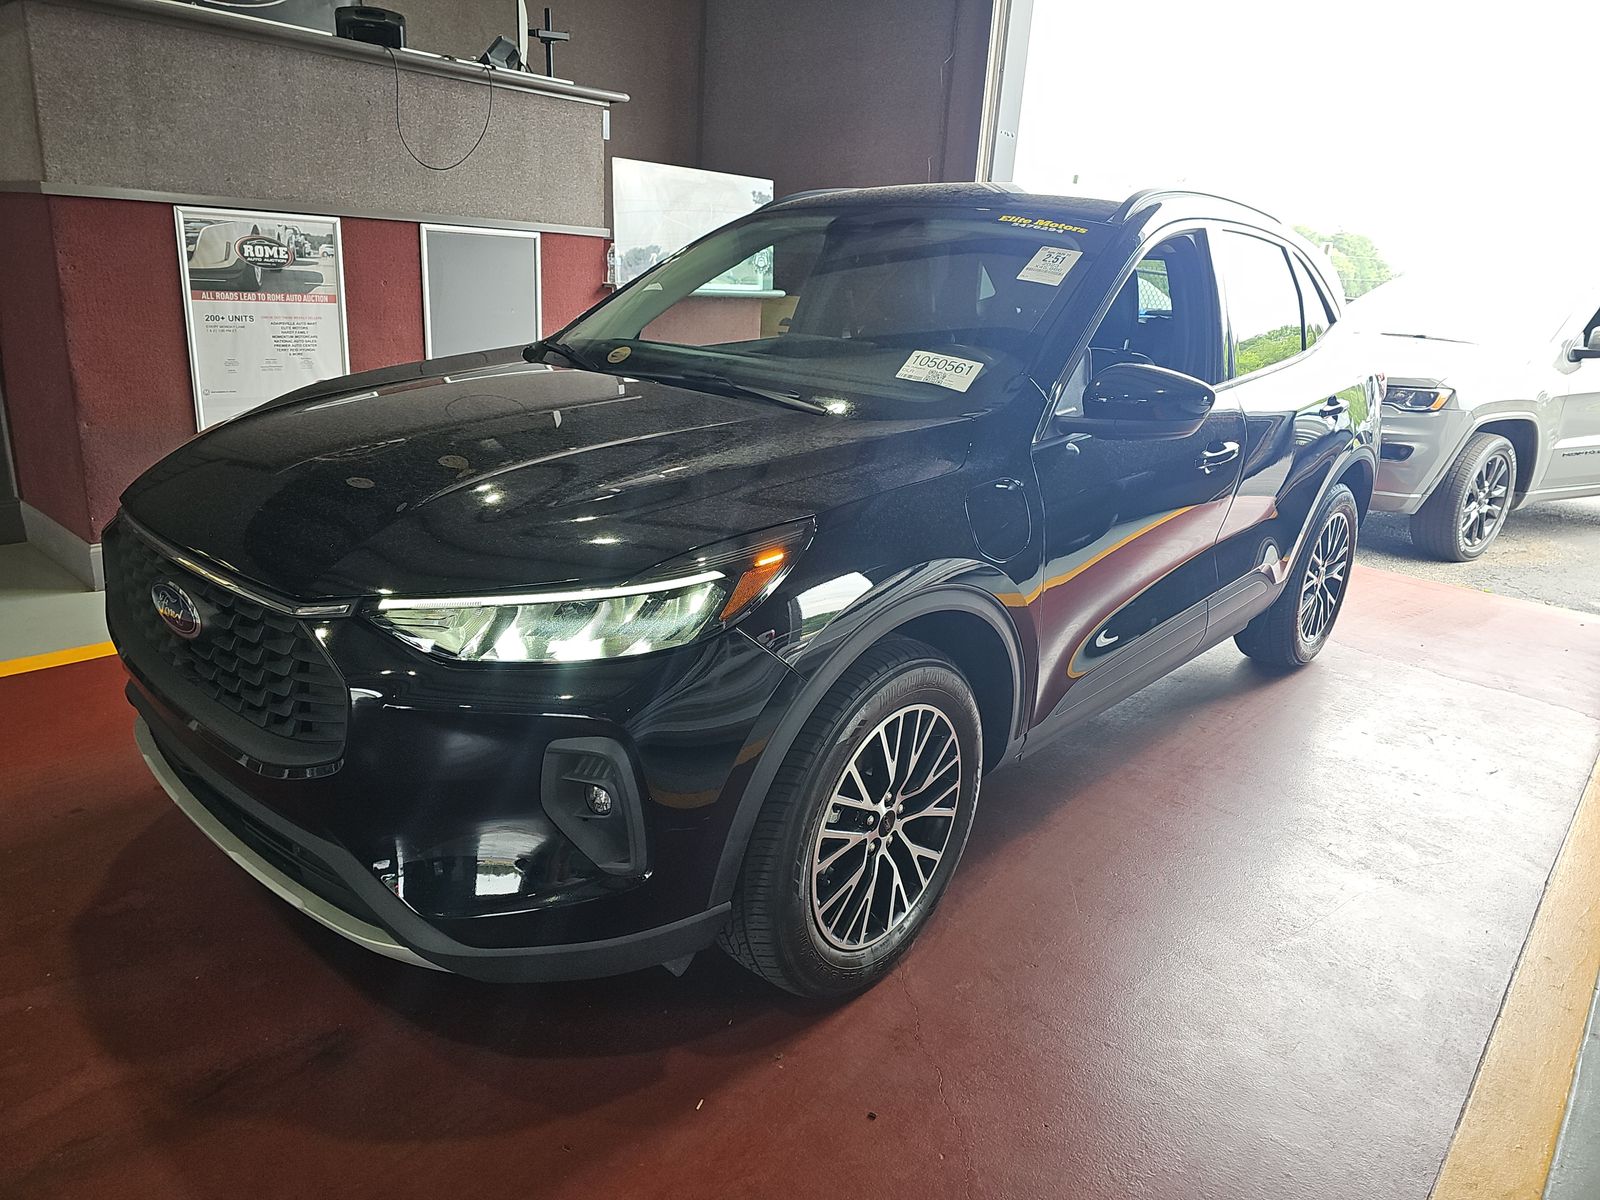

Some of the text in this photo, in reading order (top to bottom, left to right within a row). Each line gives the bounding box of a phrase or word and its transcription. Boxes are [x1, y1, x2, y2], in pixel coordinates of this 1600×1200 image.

[998, 215, 1088, 234] Elite Motors
[243, 244, 288, 258] ROME
[201, 291, 328, 303] ALL ROADS LEAD TO ROME AUTO AUCTION
[204, 314, 255, 322] 200+ UNITS
[912, 354, 974, 376] 1050561
